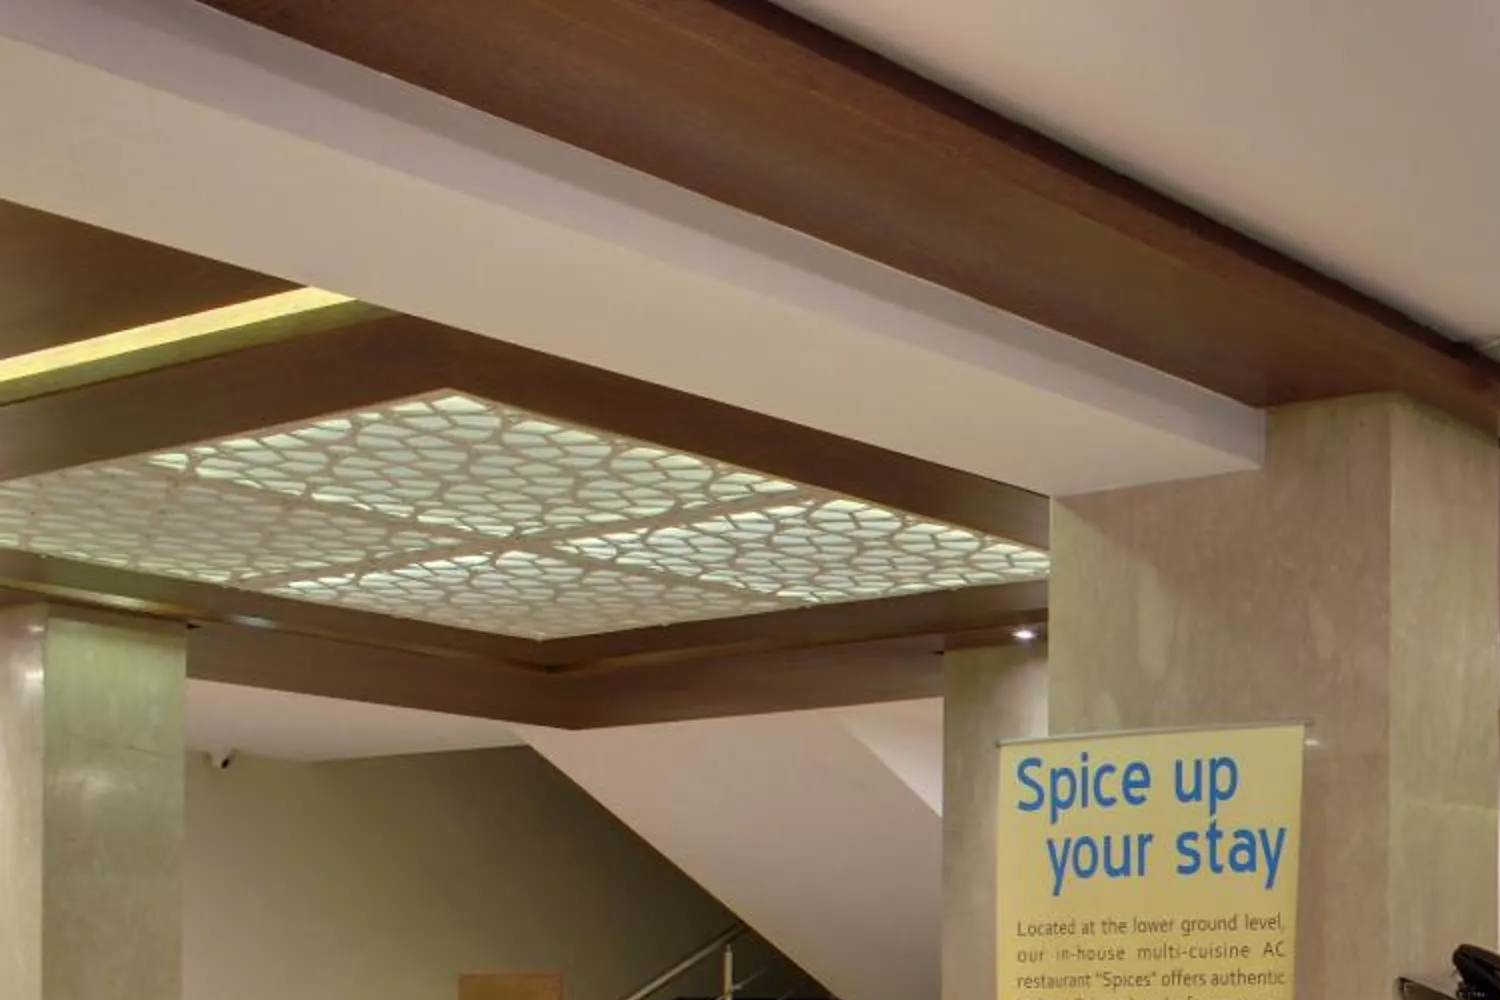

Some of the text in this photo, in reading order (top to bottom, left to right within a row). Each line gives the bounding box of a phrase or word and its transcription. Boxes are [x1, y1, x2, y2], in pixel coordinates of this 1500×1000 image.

[1017, 752, 1238, 825] Spice up
[1046, 818, 1287, 896] your stay
[1017, 919, 1076, 937] Located
[1081, 919, 1095, 934] at
[1101, 917, 1127, 934] the
[1134, 919, 1173, 933] lower
[1182, 915, 1237, 936] ground
[1018, 942, 1285, 962] our in-house multi-cuisine AC
[1017, 974, 1091, 988] restaurant
[1162, 971, 1206, 986] offers
[1211, 971, 1285, 985] authentic
